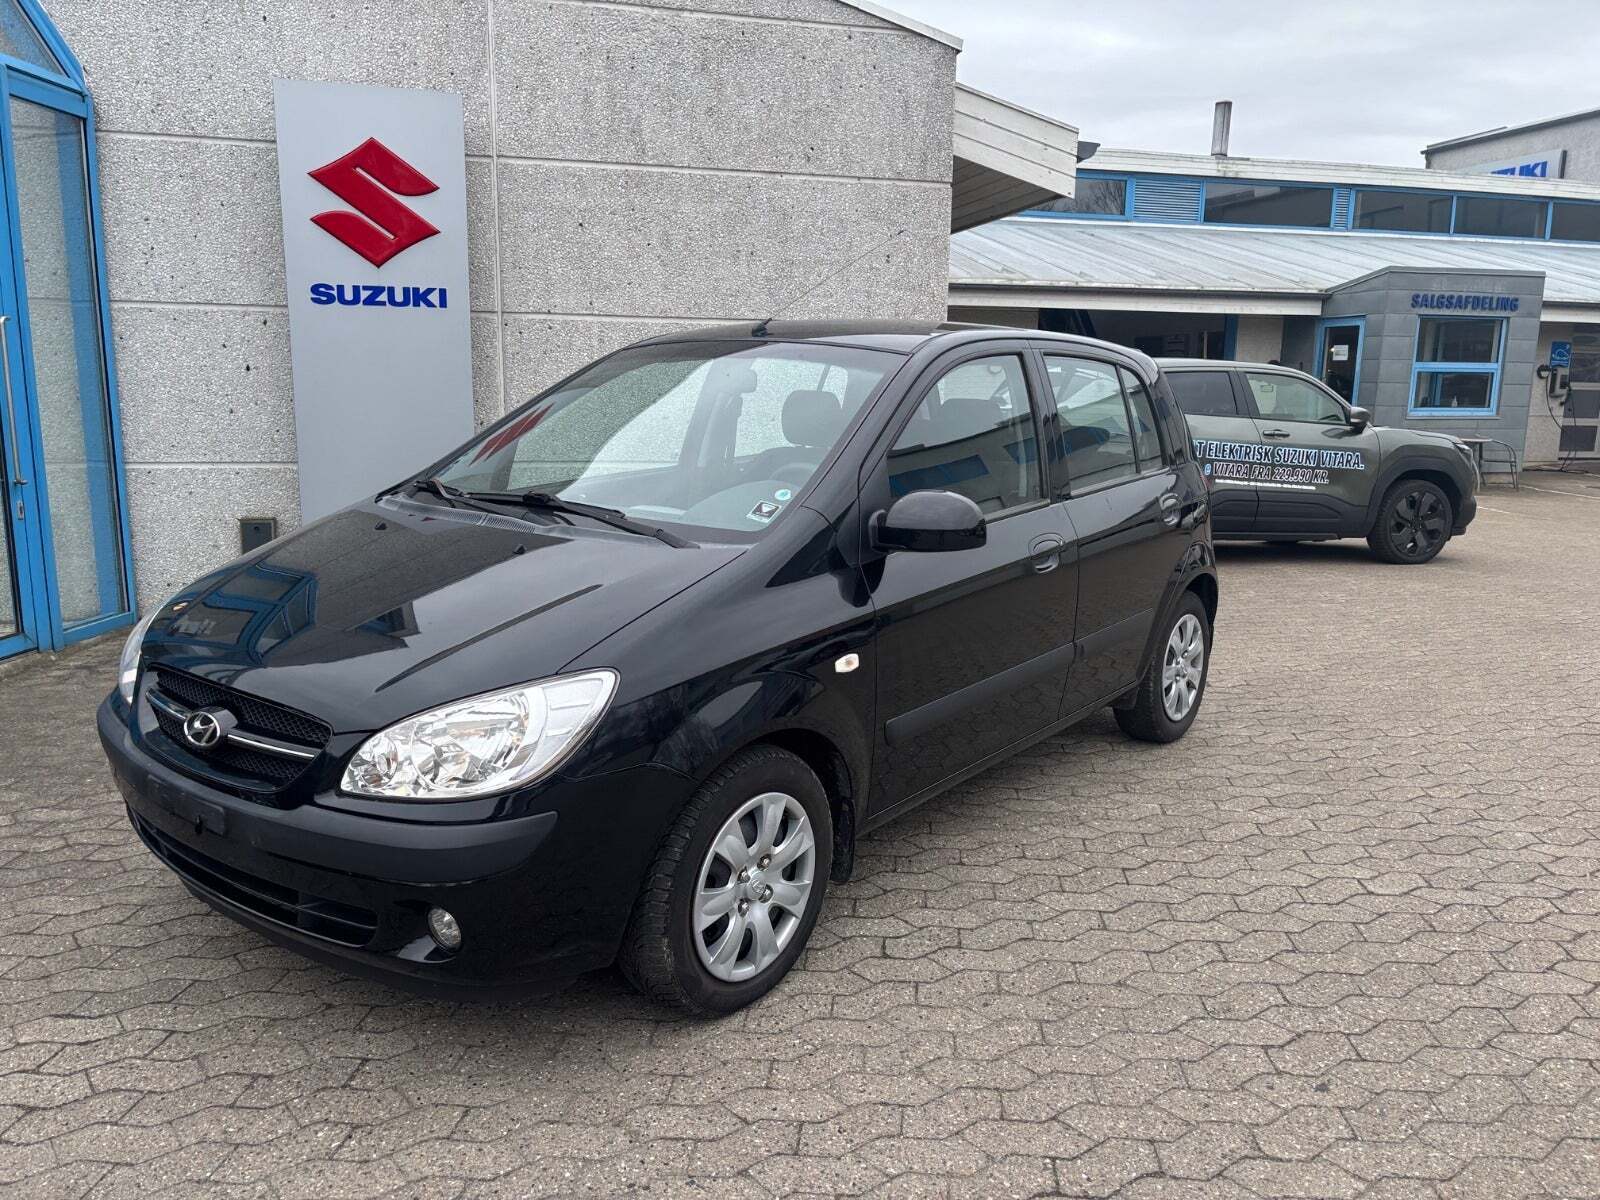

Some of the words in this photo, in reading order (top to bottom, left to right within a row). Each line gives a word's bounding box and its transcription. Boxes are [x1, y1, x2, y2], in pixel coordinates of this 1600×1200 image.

[1491, 160, 1547, 177] UKI
[310, 283, 447, 308] SUZUKI
[1411, 293, 1519, 312] SALGSAFDELING
[1193, 439, 1206, 458] T
[1206, 441, 1273, 463] ELEKTRISK
[1274, 446, 1318, 467] SUZUKI
[1320, 450, 1365, 470] VITARA.
[1213, 461, 1250, 479] VITARA
[1250, 464, 1272, 481] FRA
[1272, 466, 1313, 483] 229.990
[1311, 469, 1330, 485] KR.
